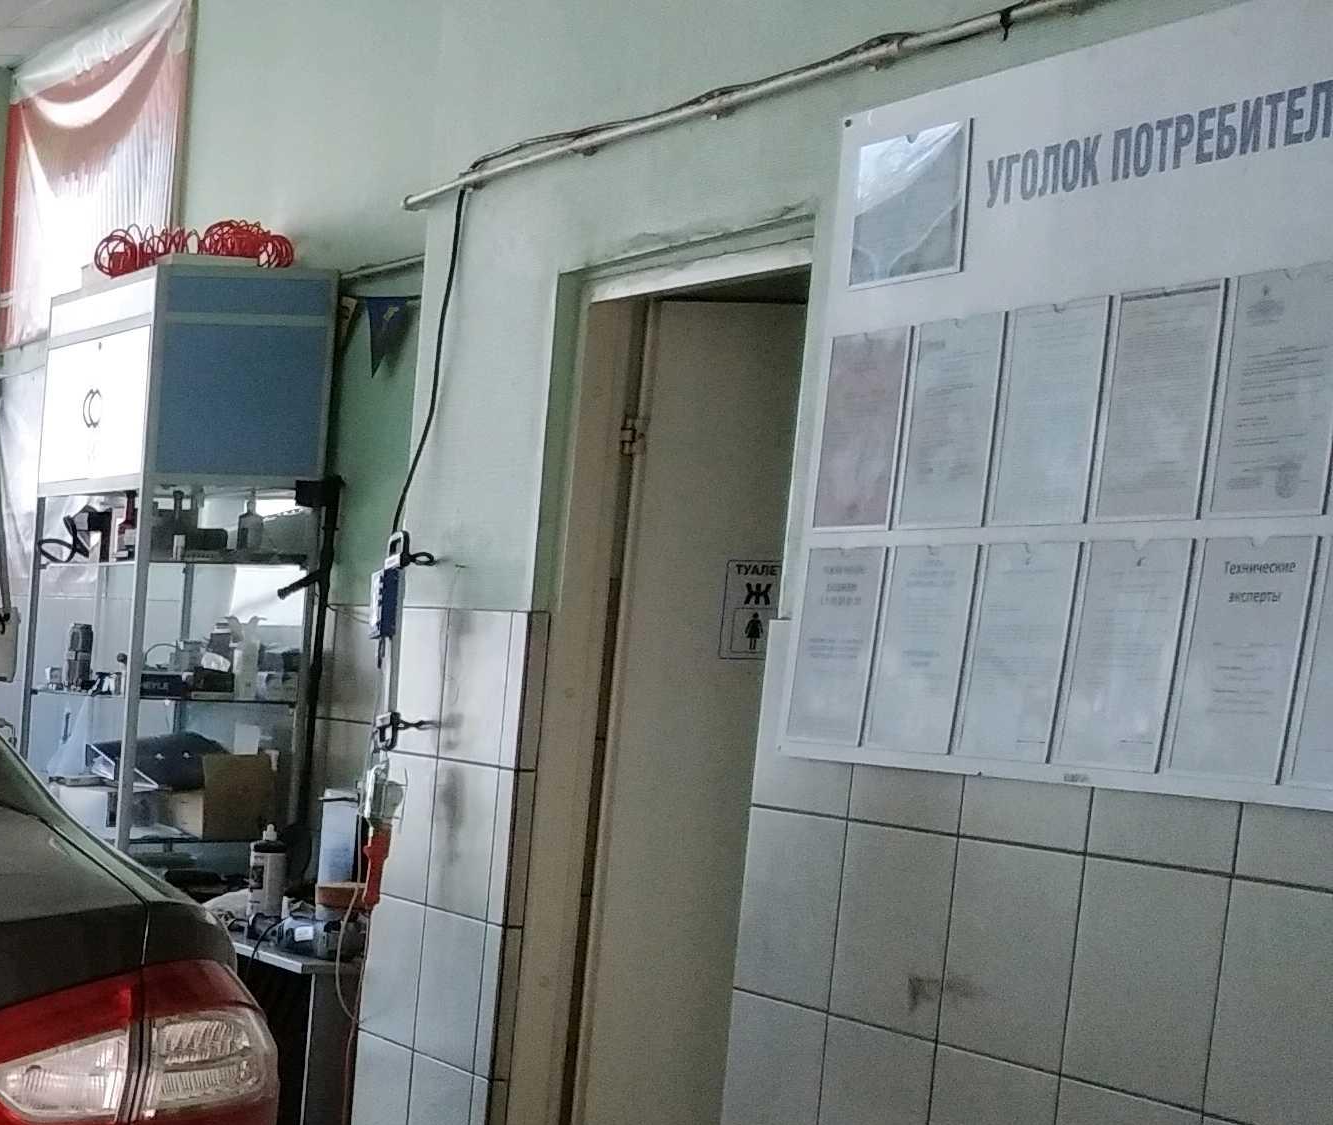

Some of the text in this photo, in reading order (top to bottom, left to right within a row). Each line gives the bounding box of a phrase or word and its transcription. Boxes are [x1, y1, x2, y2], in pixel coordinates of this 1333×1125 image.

[986, 79, 1333, 208] УГОЛОК ПОТРЕБИТЕЛ
[1224, 560, 1297, 575] Технические
[744, 582, 772, 605] Ж
[1228, 590, 1282, 604] эксперты
